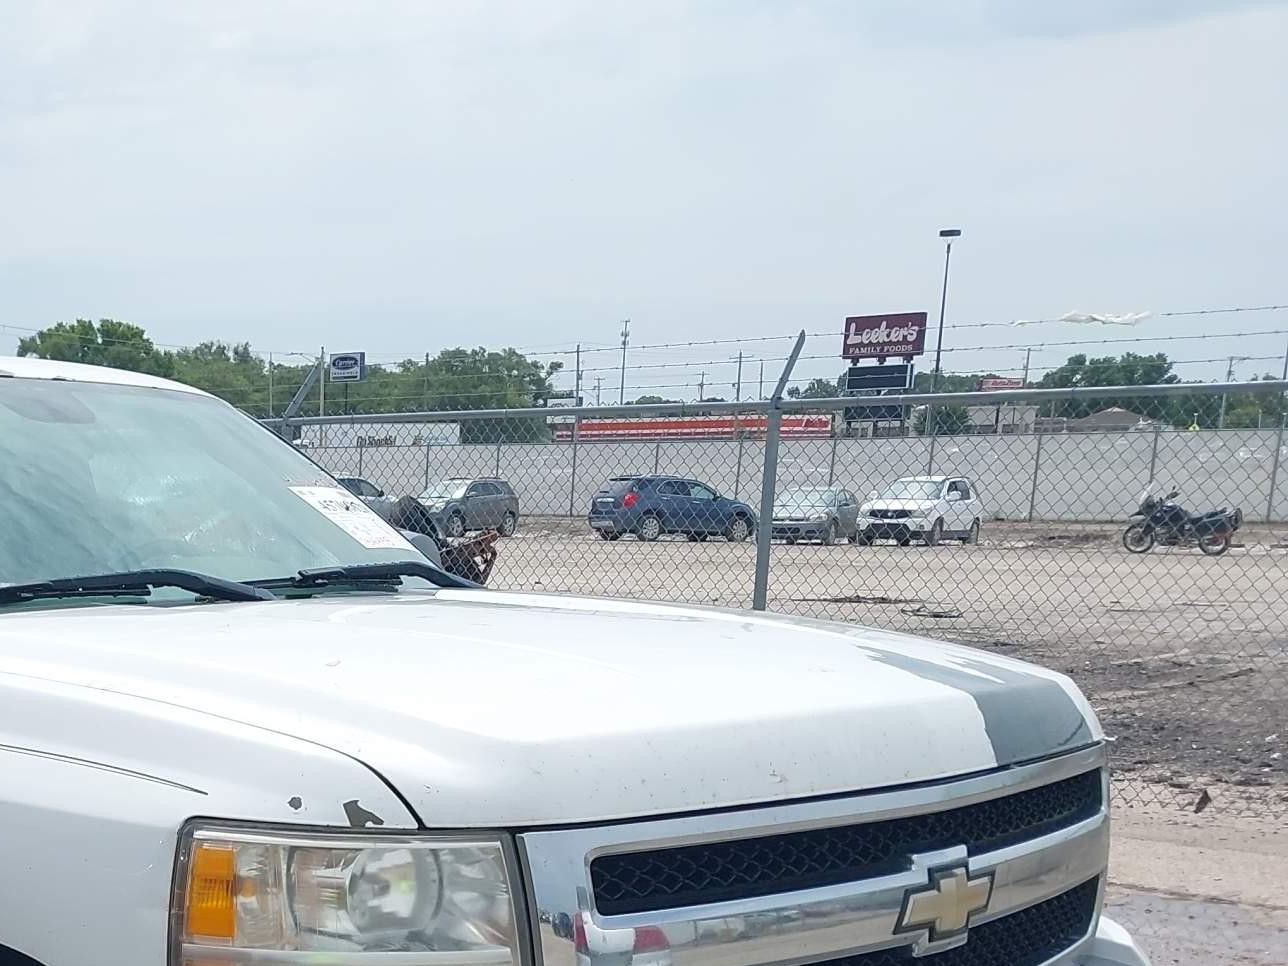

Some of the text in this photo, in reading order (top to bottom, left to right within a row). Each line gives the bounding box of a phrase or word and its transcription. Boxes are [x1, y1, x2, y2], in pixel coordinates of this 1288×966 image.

[846, 320, 919, 345] Leeker's
[849, 344, 913, 355] FAMILY FOODS
